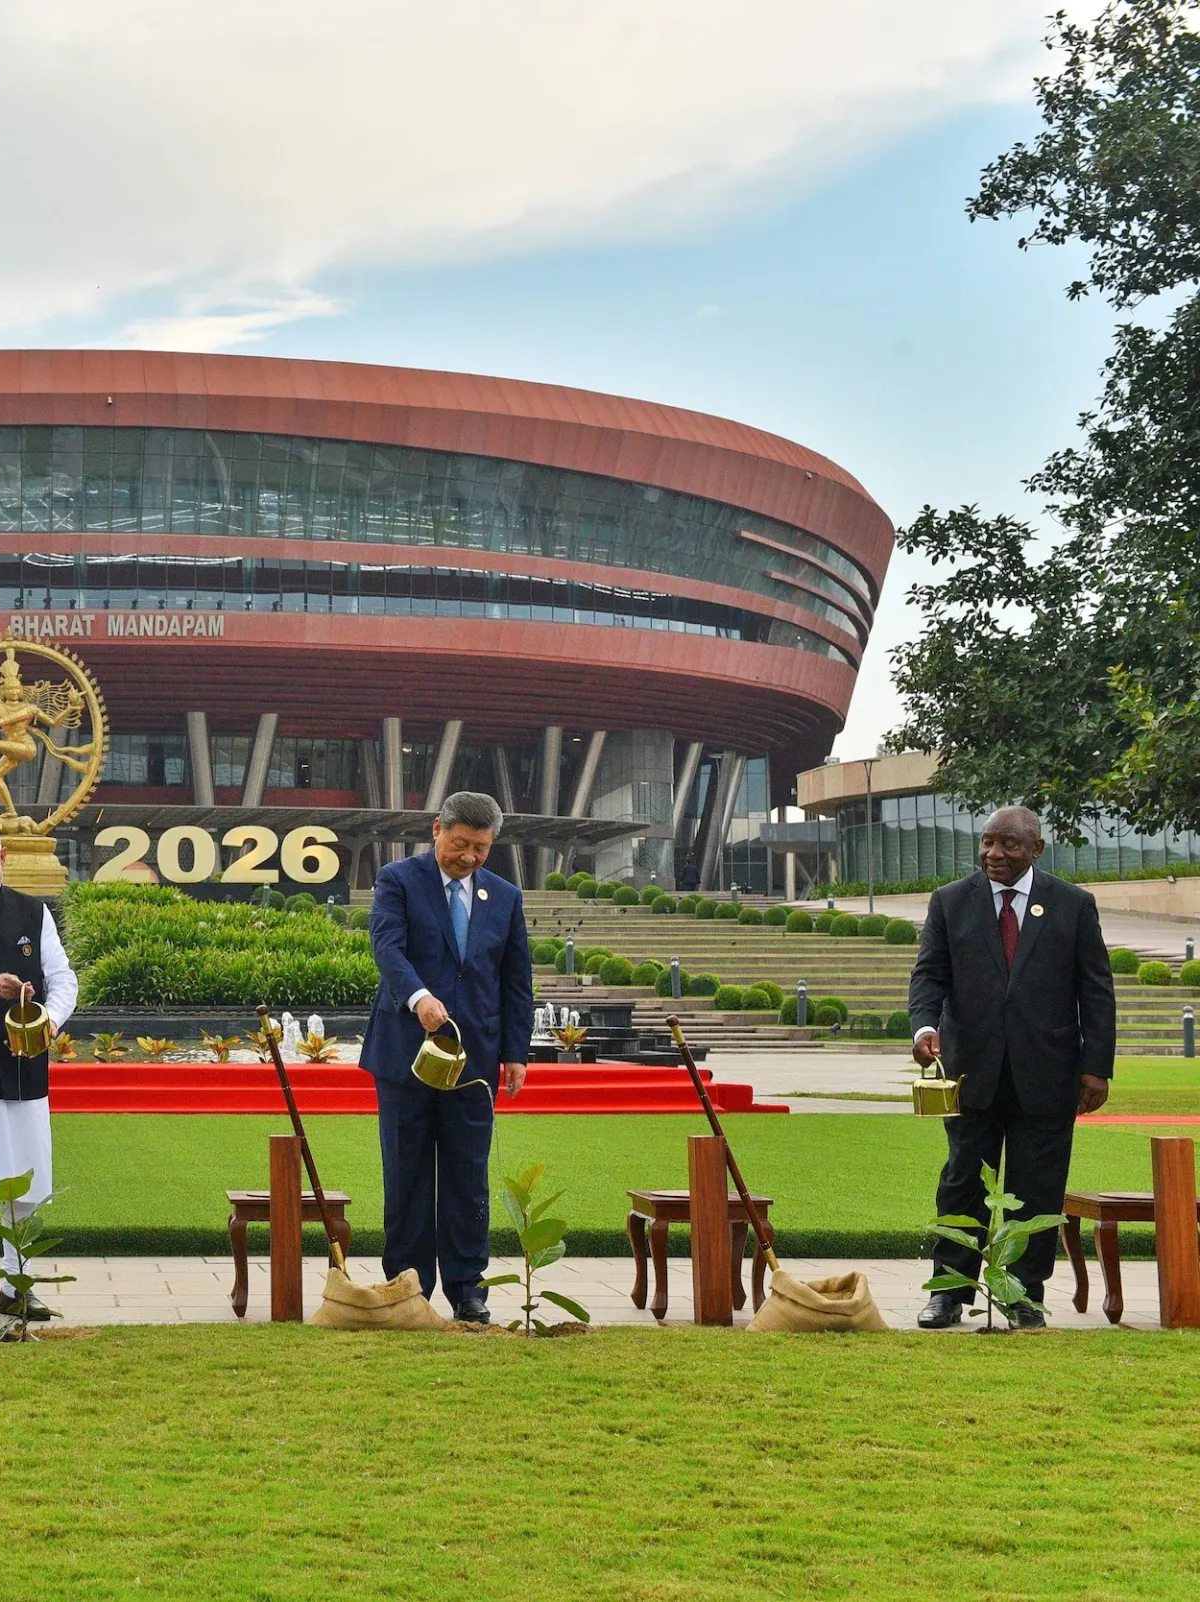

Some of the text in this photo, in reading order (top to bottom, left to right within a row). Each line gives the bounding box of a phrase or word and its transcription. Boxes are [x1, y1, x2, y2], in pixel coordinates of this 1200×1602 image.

[10, 614, 224, 637] BHARAT MANDAPAM
[92, 825, 340, 883] 2026
